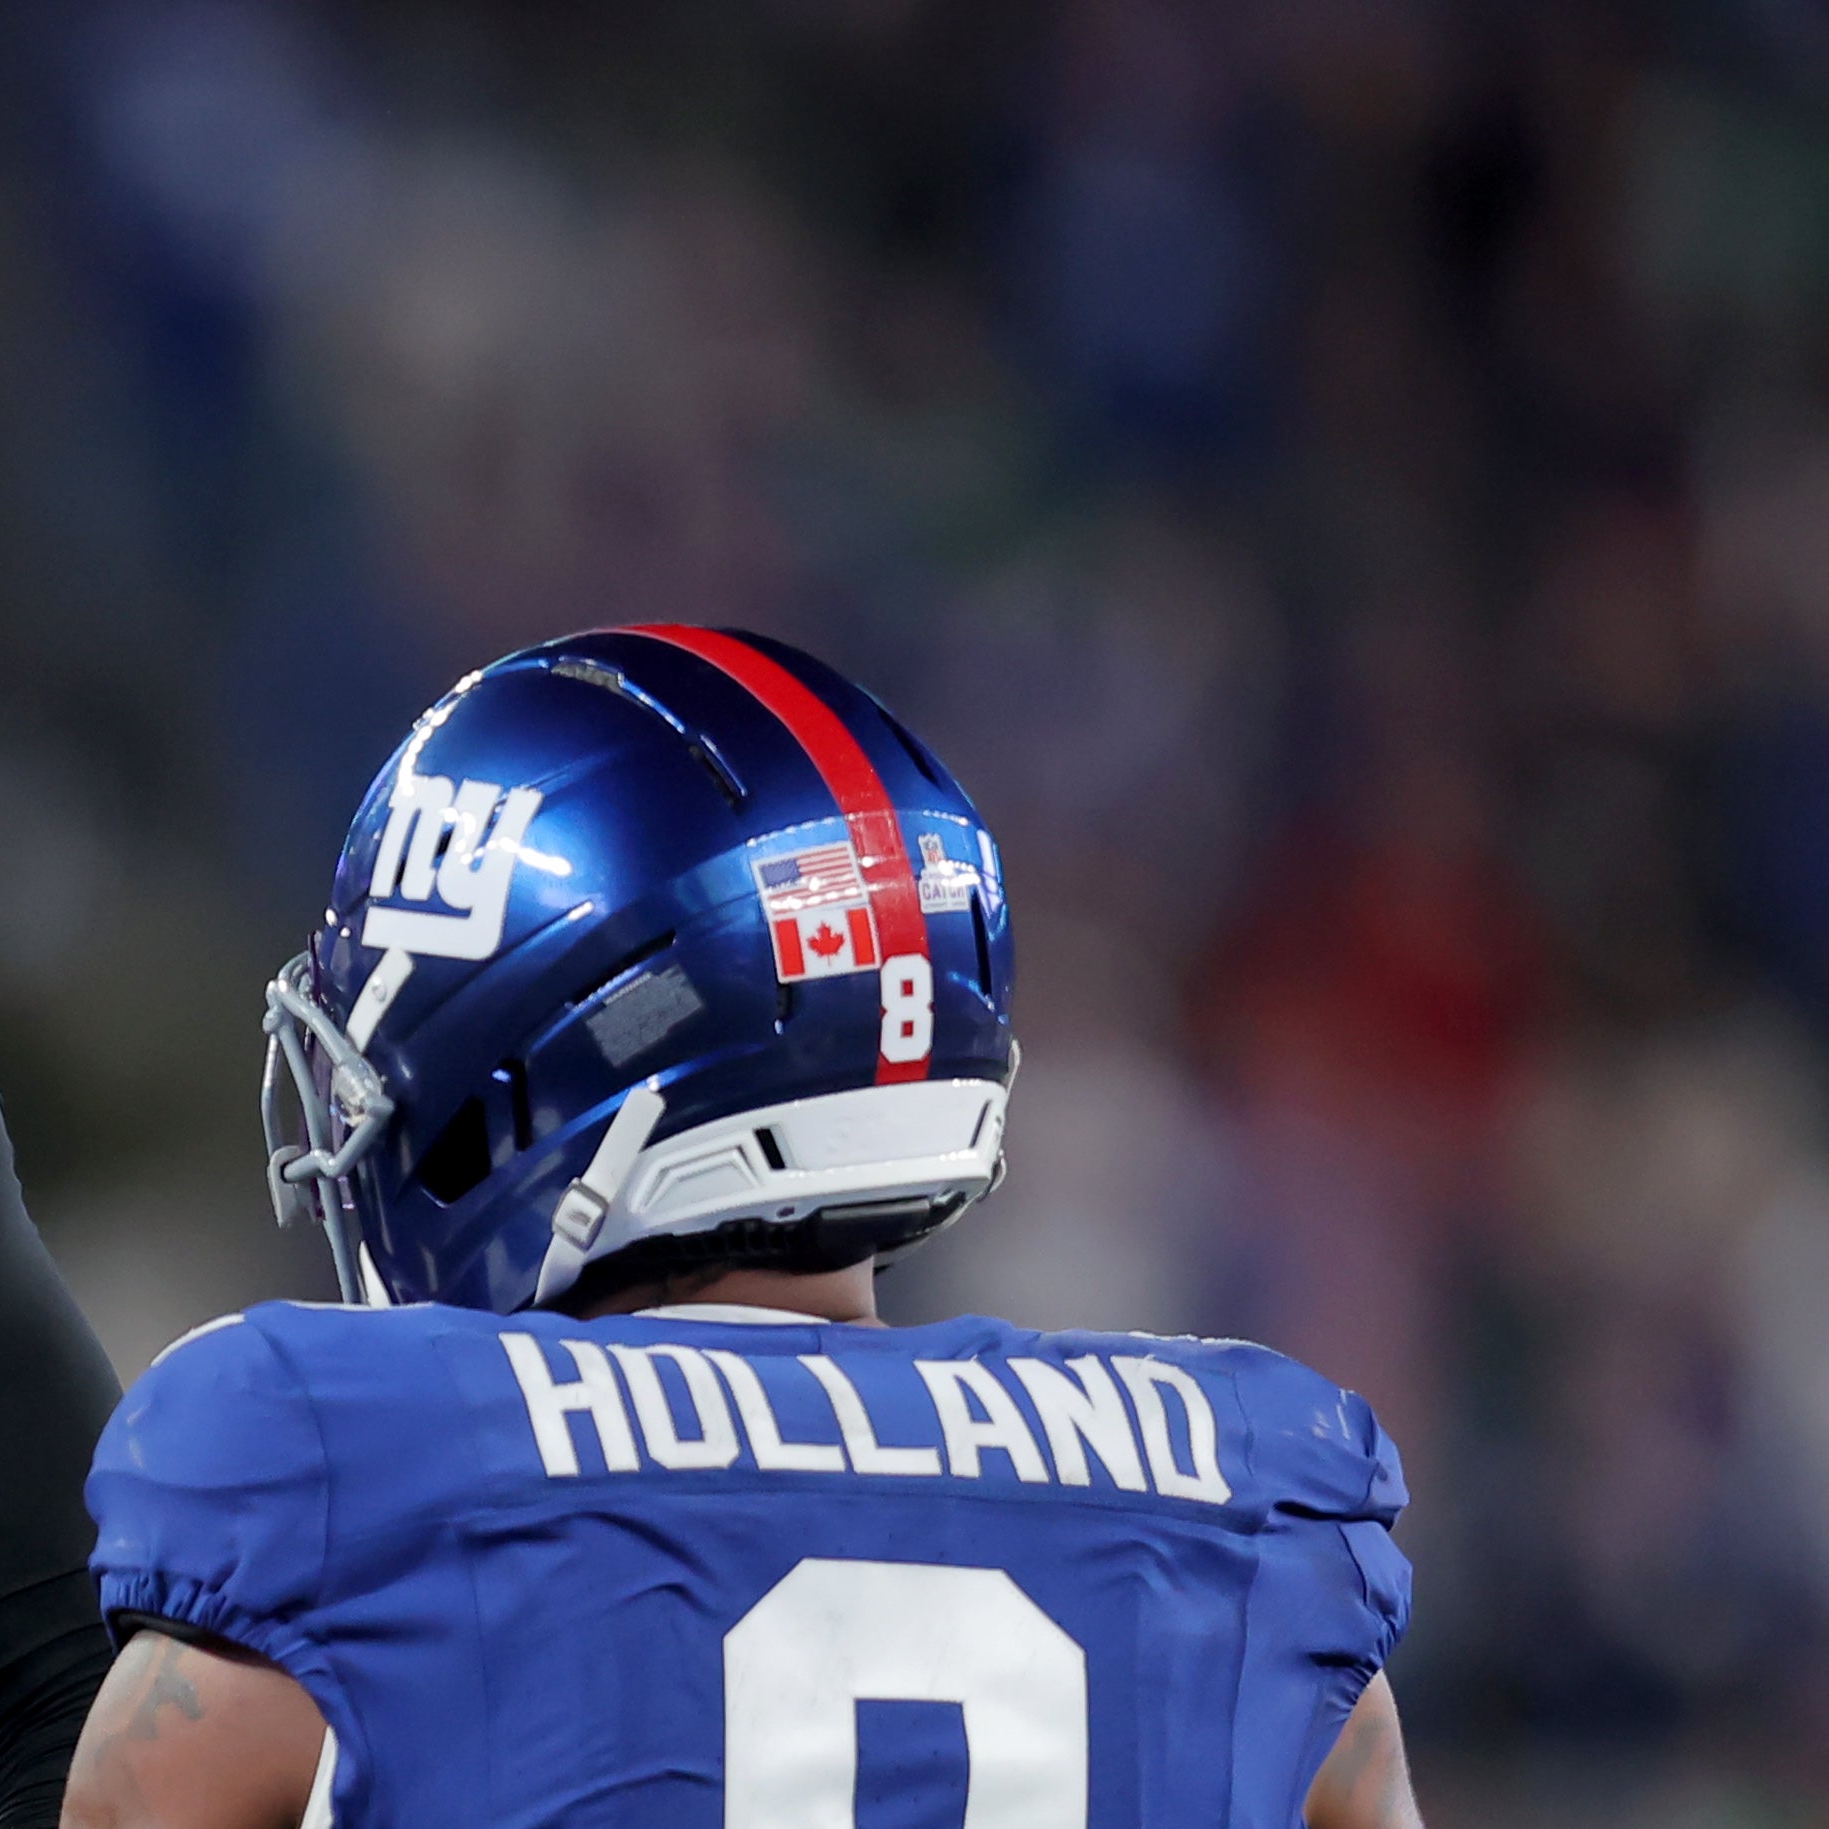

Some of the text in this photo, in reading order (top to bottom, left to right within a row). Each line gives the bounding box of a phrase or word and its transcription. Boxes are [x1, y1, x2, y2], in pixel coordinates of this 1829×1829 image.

[362, 773, 543, 961] ny
[879, 953, 934, 1063] 8
[499, 1332, 1234, 1505] HOLLAND
